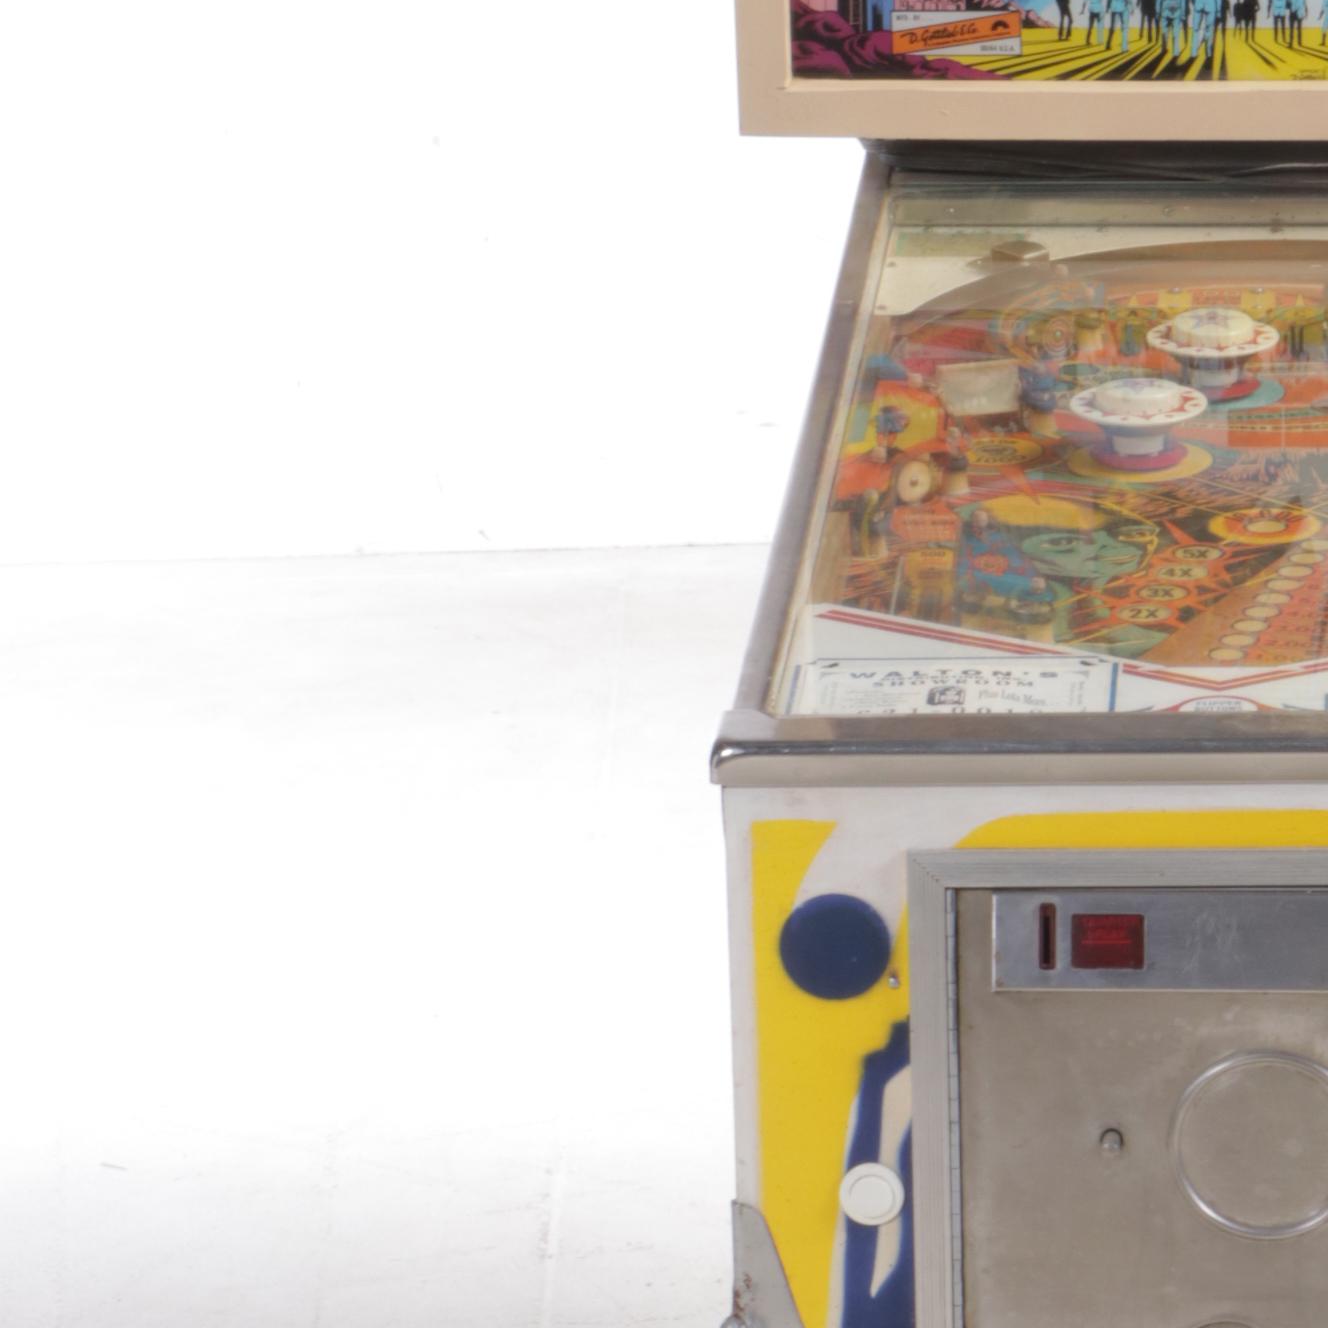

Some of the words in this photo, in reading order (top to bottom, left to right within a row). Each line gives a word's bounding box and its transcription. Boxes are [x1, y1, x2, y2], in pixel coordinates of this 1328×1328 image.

[1182, 549, 1209, 559] 5X
[1163, 567, 1193, 577] 4X
[1146, 587, 1174, 598] 3X
[1129, 608, 1160, 619] 2X
